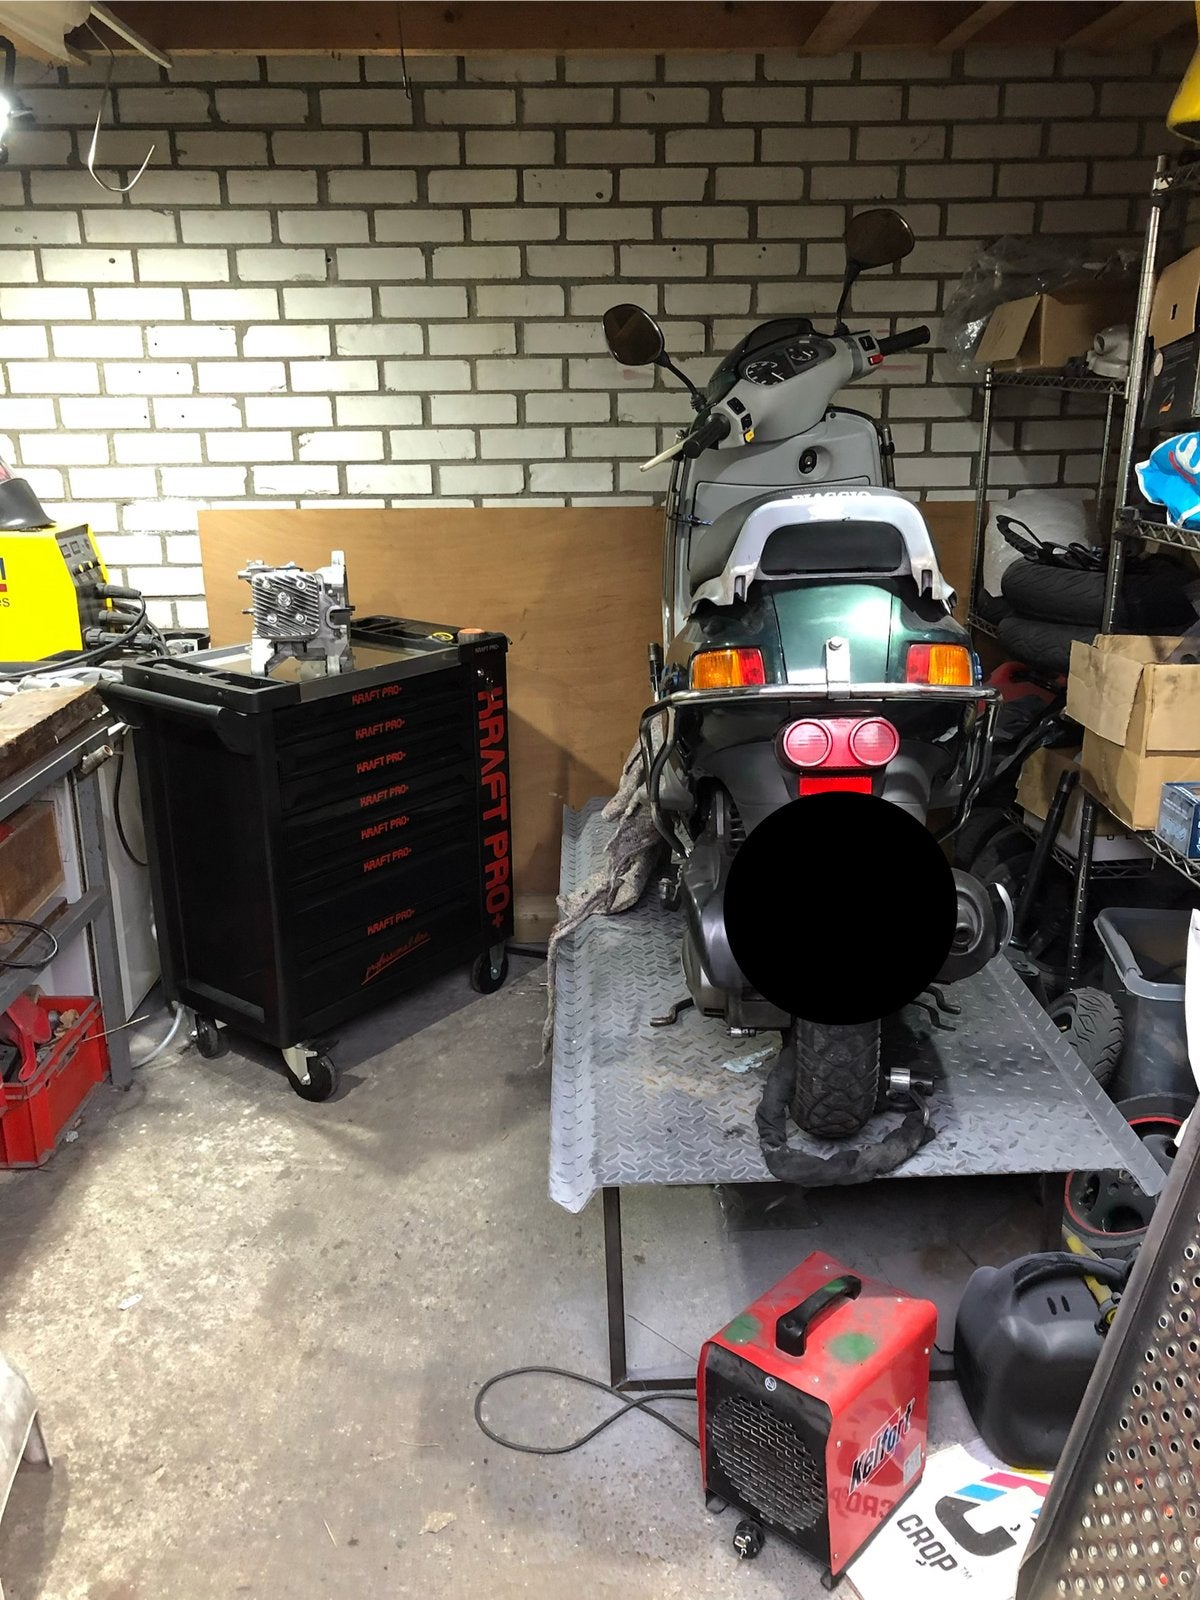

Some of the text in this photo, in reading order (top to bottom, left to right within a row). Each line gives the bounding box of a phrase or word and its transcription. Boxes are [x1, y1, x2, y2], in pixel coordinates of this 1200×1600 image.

[352, 689, 381, 705] KRAFT
[355, 721, 385, 740] KRAFT
[478, 686, 508, 822] KRAFT
[356, 755, 386, 774] KRAFT
[360, 788, 389, 807] KRAFT
[361, 821, 389, 840] KRAFT
[363, 853, 391, 872] KRAFT
[368, 915, 394, 936] KRAFT
[849, 1398, 915, 1495] Kelfort
[897, 1514, 958, 1571] CROP
